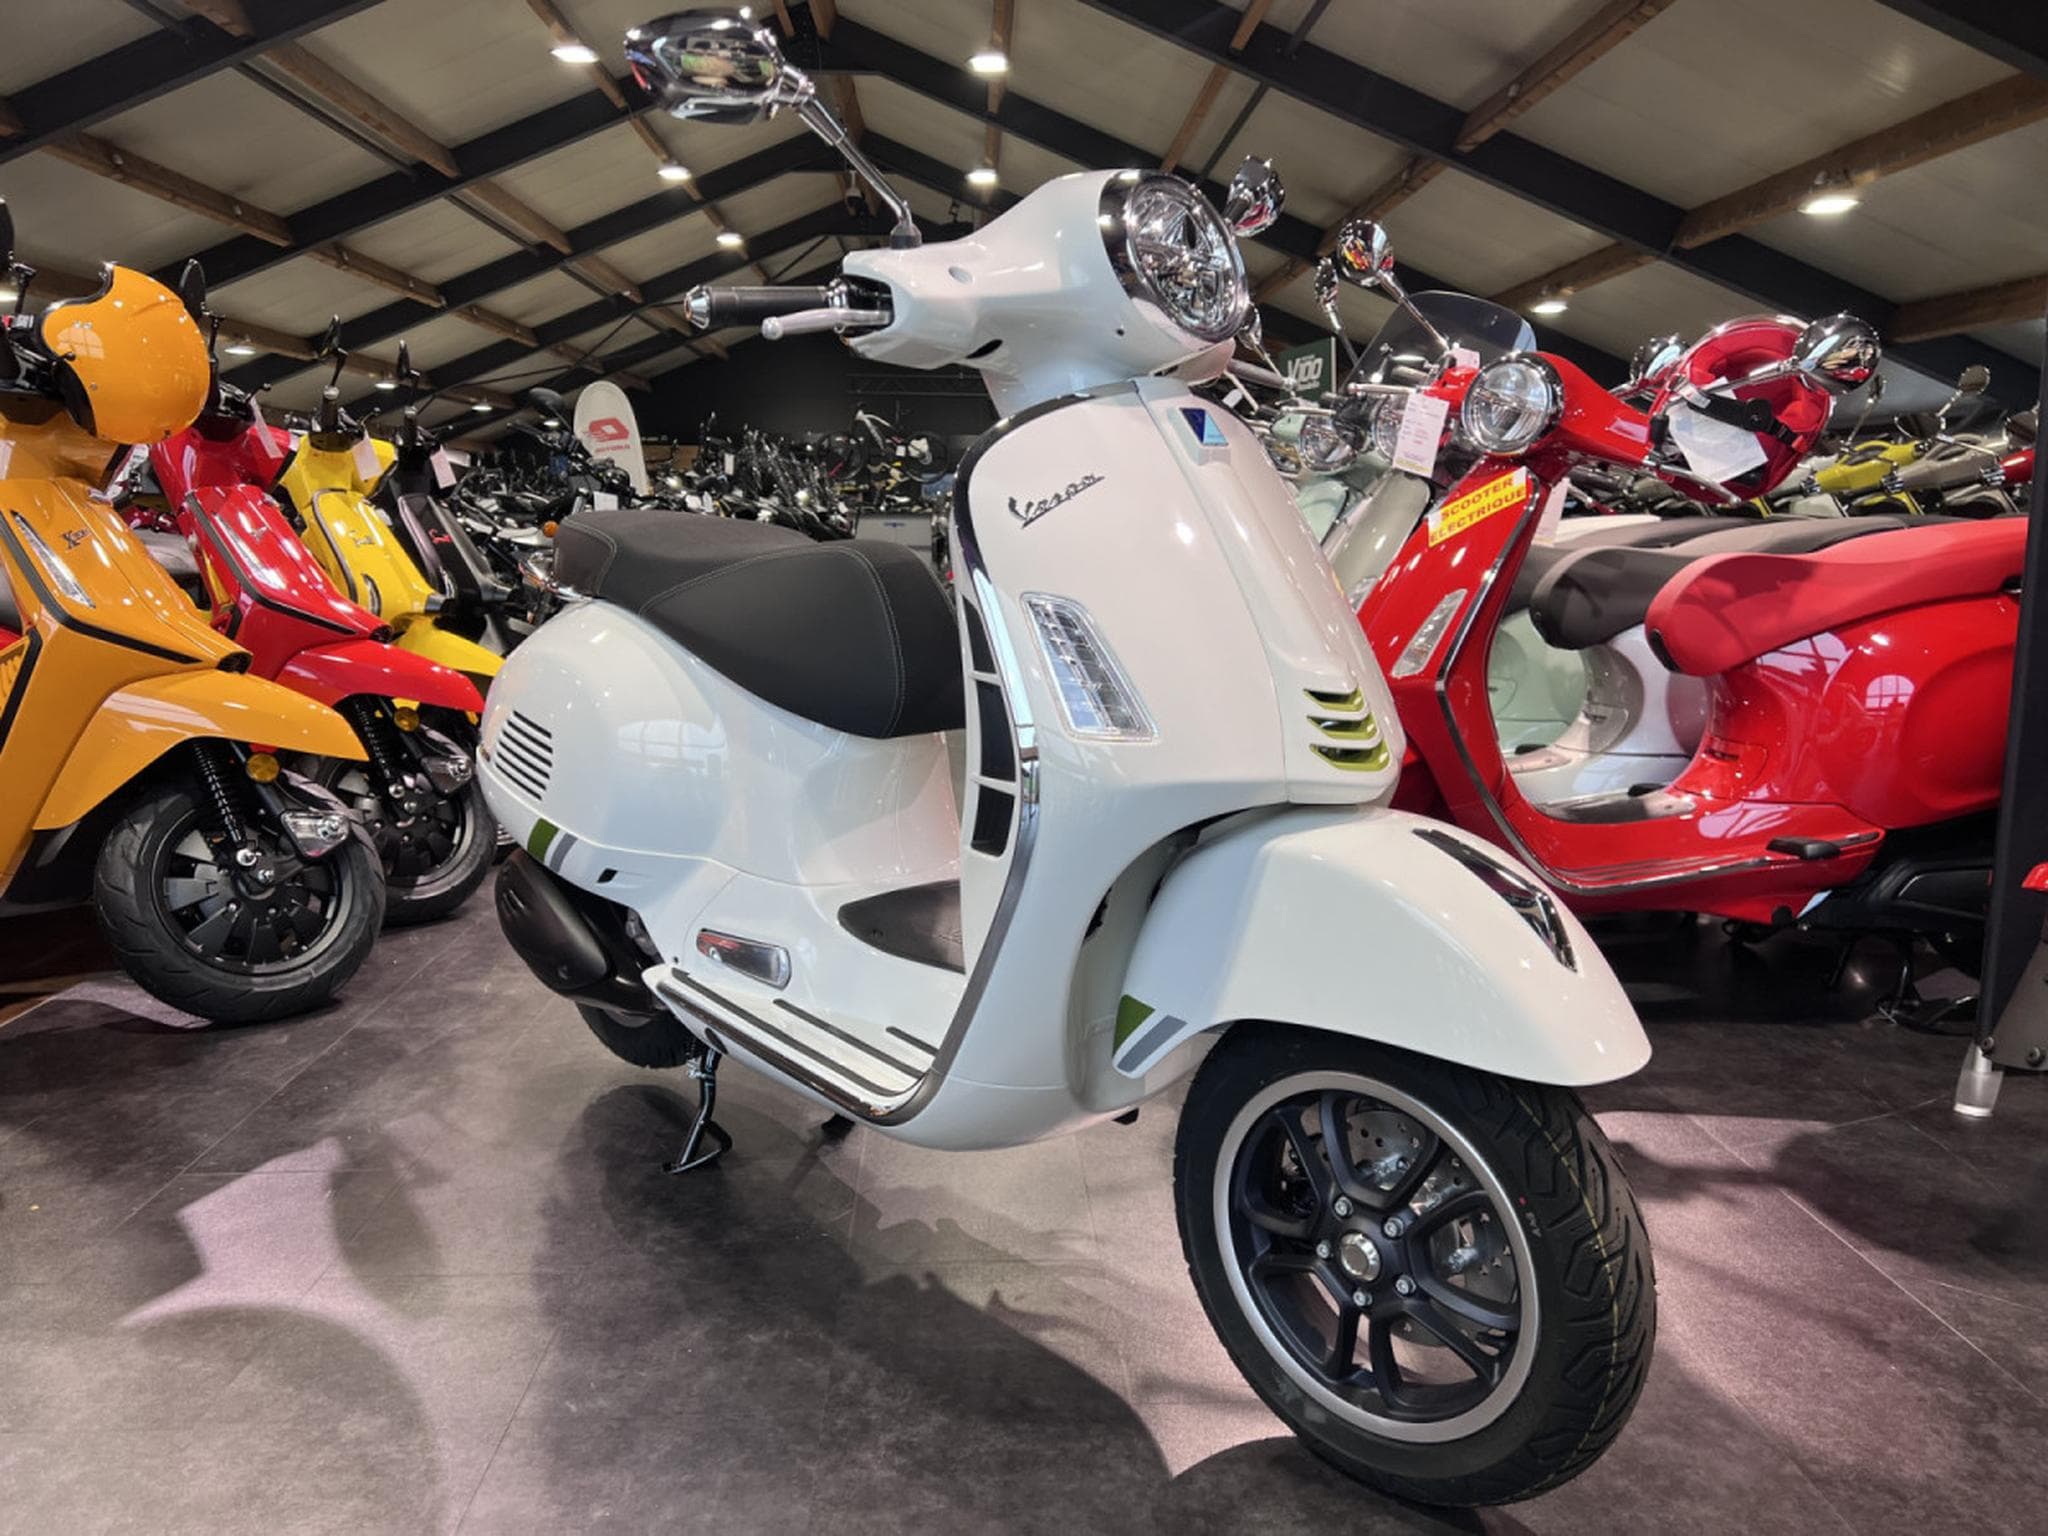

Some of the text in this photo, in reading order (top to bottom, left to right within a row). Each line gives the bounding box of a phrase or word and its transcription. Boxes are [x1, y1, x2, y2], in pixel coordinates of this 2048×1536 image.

[1008, 473, 1105, 528] Vespa
[1430, 486, 1526, 543] ELECTRIQUE
[1440, 477, 1514, 520] SCOOTER
